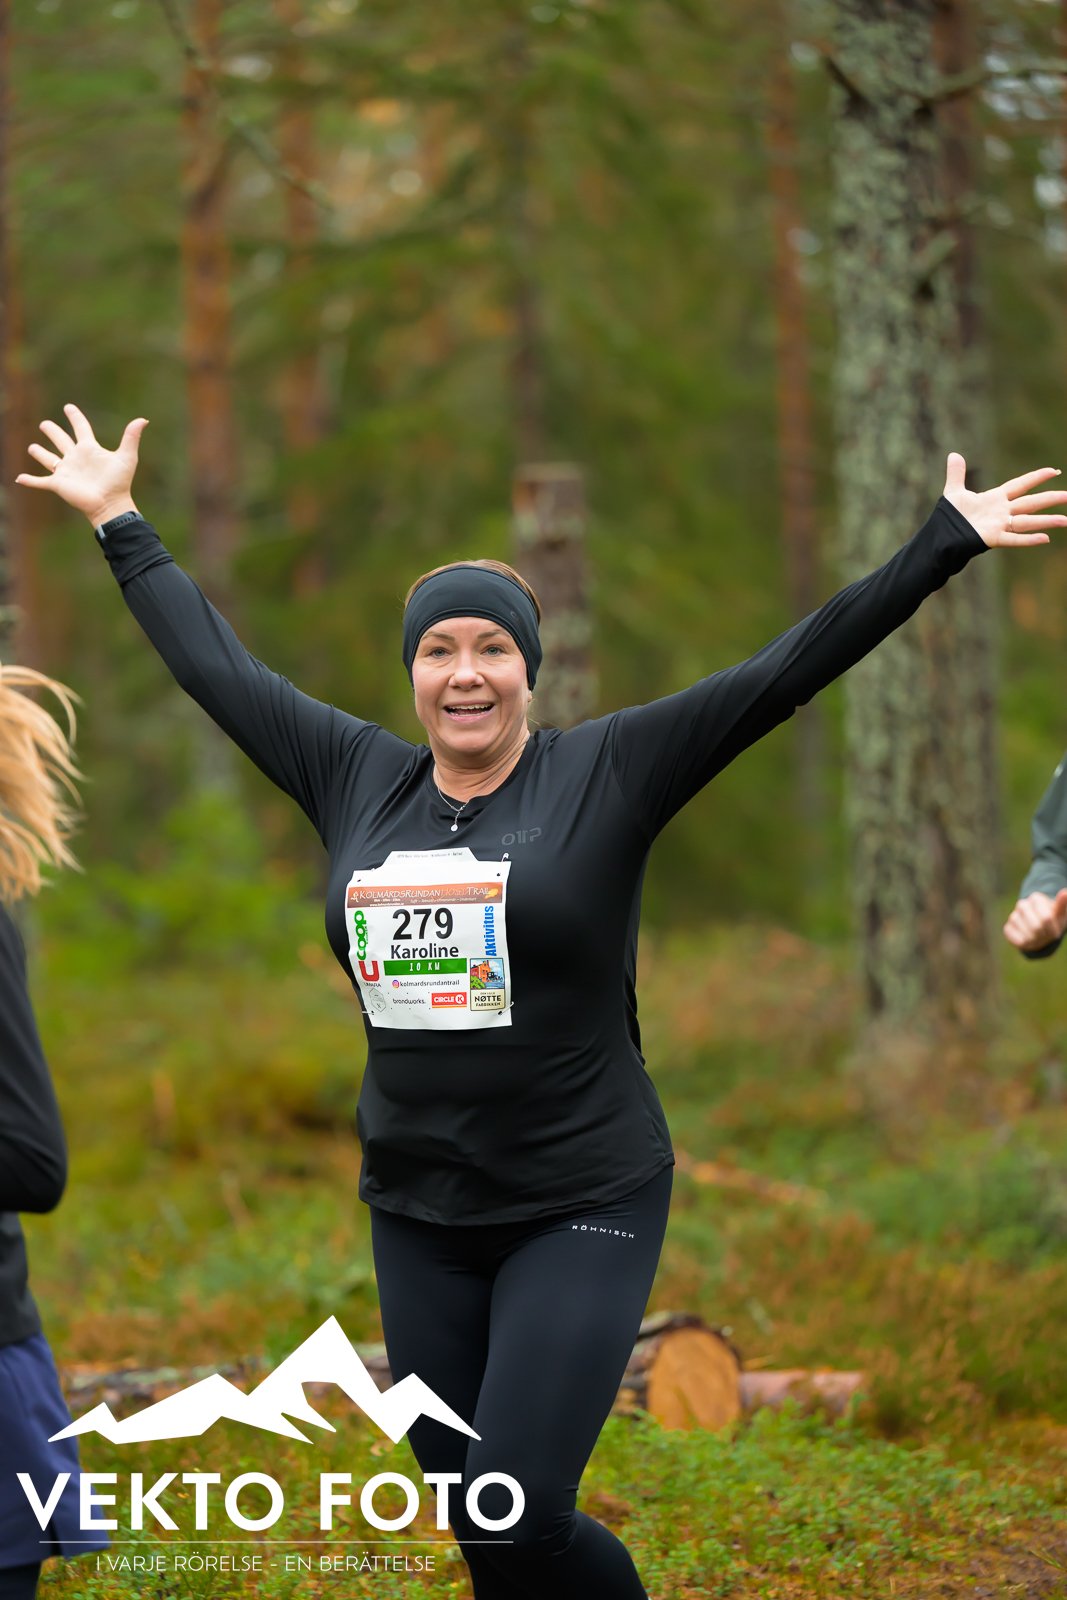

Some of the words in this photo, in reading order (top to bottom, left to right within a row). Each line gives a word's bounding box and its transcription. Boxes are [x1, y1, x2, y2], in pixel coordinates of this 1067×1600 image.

[392, 907, 454, 941] 279
[484, 905, 497, 957] Aktivitus
[390, 943, 459, 960] Karoline
[409, 962, 421, 971] 10
[428, 961, 441, 971] KM
[400, 979, 460, 988] kolmardsrundantrail
[456, 995, 464, 1003] K
